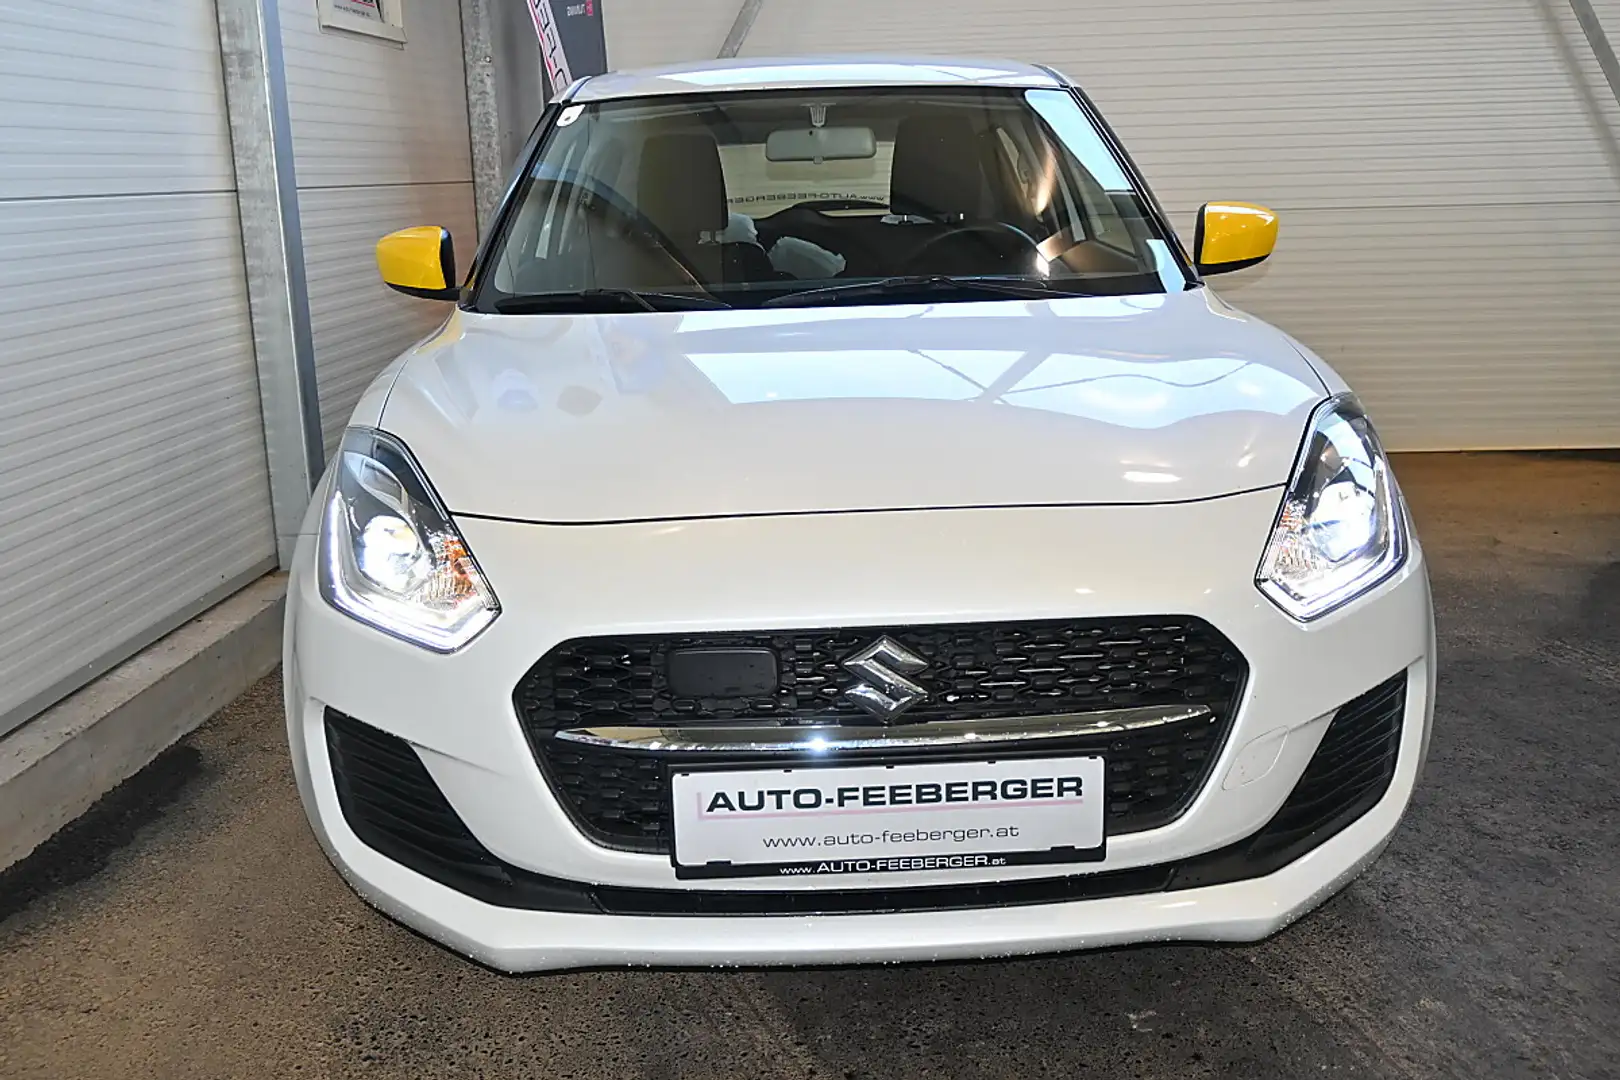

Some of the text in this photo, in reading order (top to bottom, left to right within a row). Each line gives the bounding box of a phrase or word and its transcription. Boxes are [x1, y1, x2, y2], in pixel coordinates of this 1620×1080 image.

[706, 777, 1083, 812] AUTO-FEEBERGER
[763, 826, 1019, 848] www.auto-feeberger.at
[779, 855, 1006, 875] www.AUTO-FEEBERGER.at
